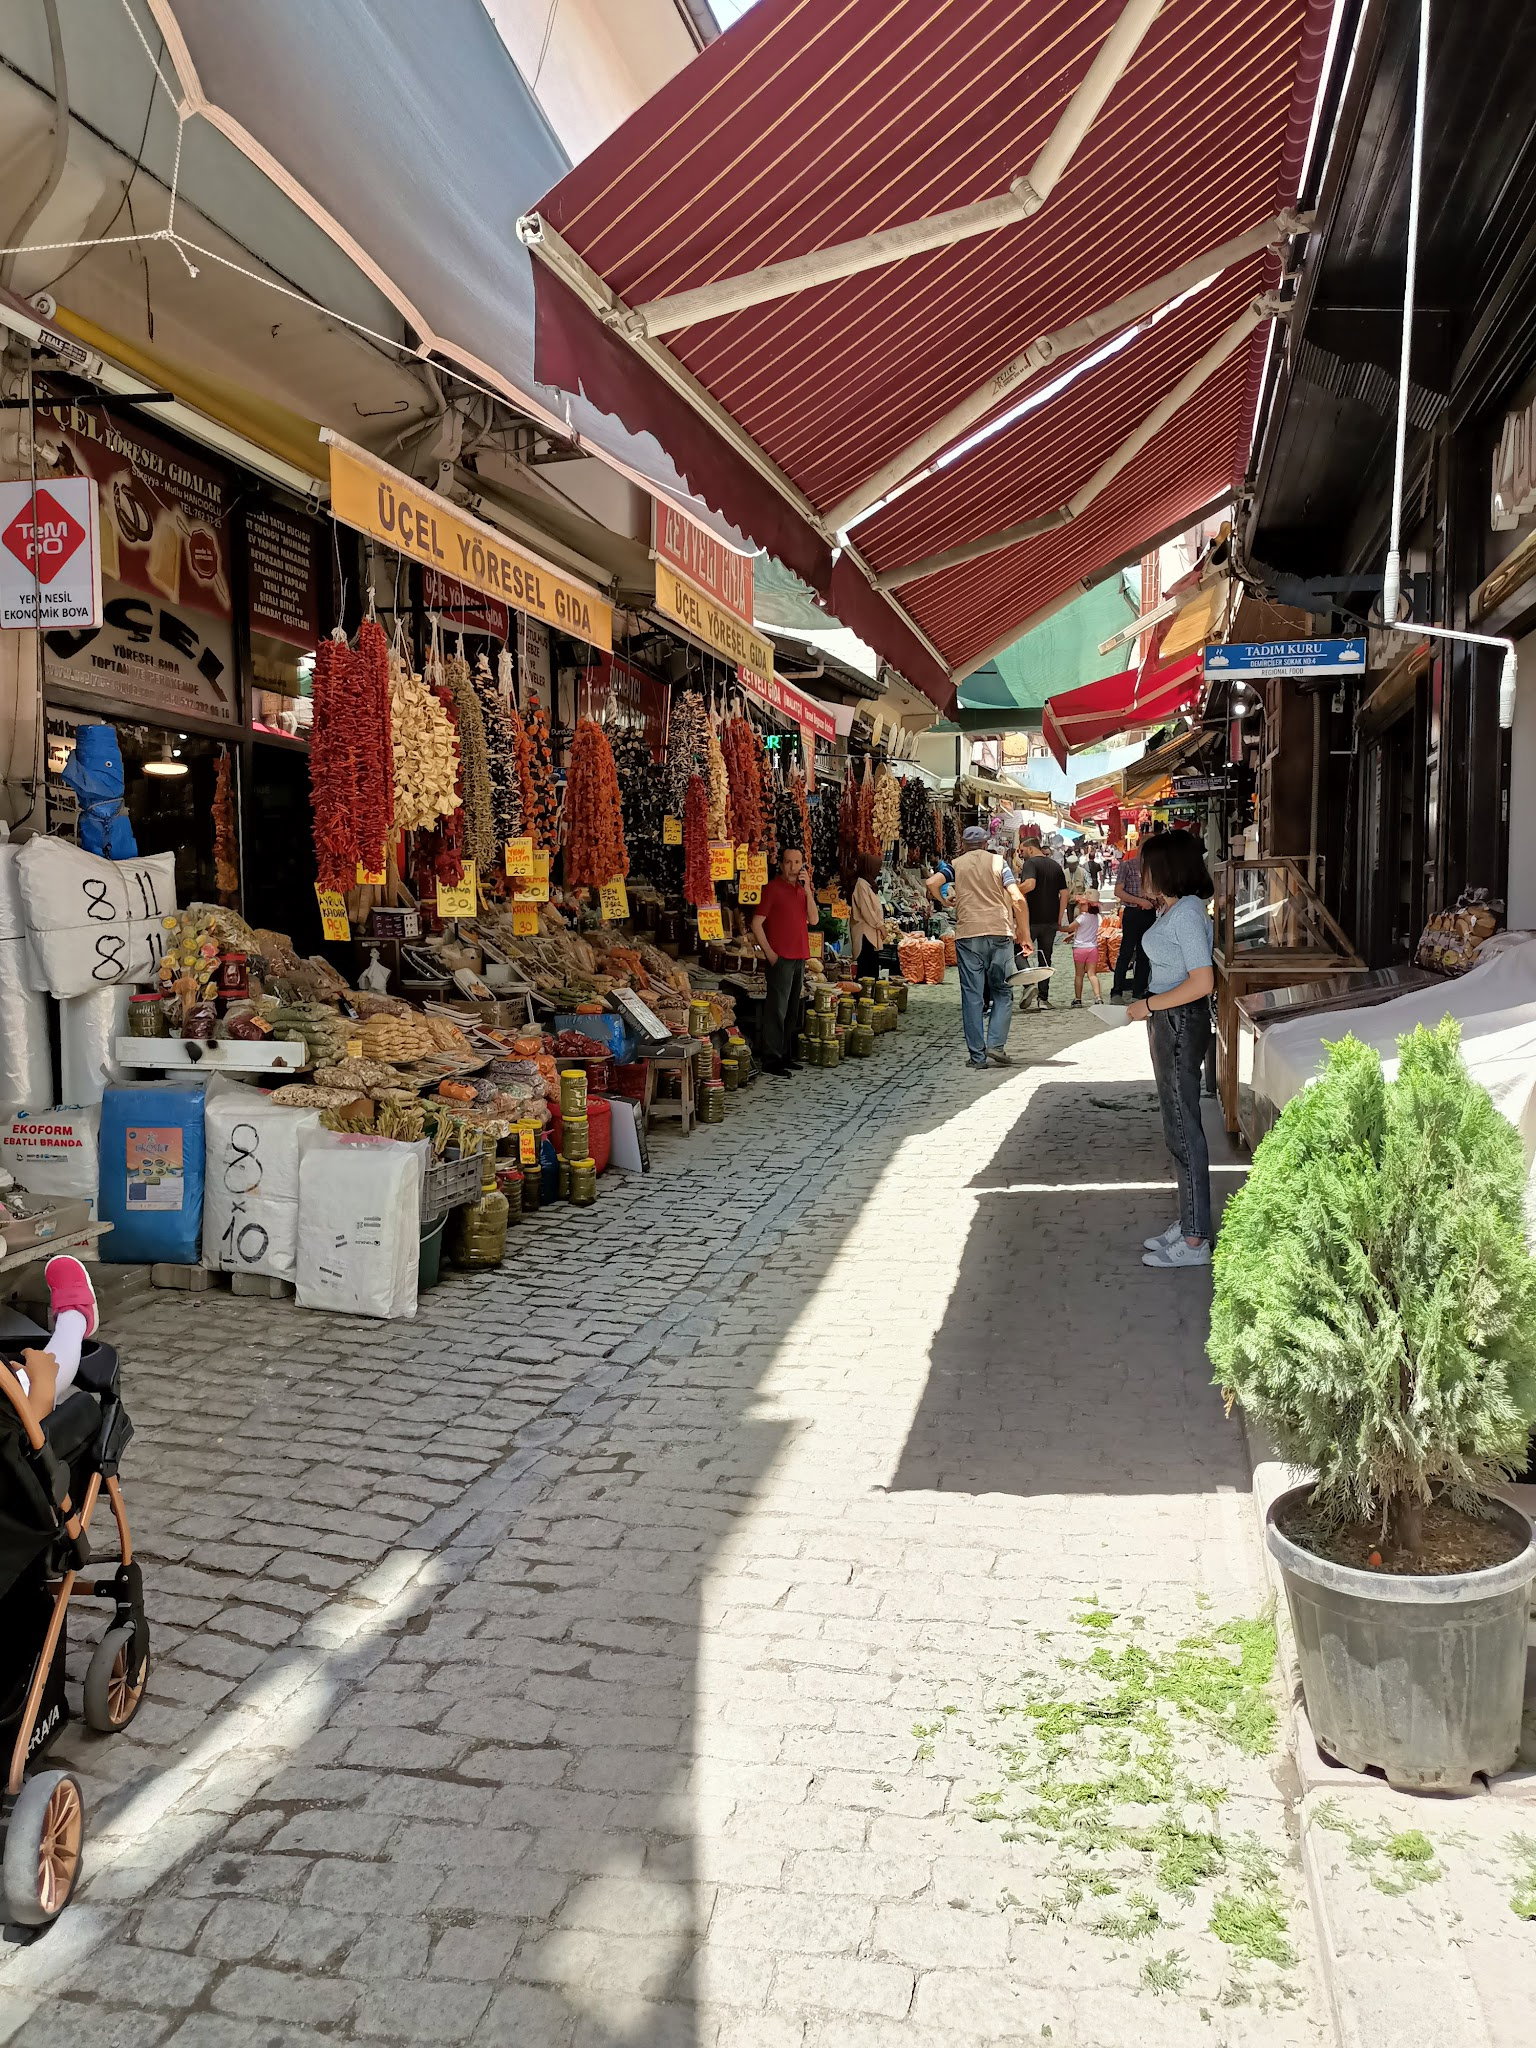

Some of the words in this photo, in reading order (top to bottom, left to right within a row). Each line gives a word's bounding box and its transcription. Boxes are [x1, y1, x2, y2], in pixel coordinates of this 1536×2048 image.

[105, 427, 167, 476] YÖRESEL
[169, 462, 222, 504] GIDALAR
[164, 481, 183, 498] Mutlu
[377, 482, 444, 559] ÜÇEL
[456, 533, 546, 610] YÖRESEL
[554, 588, 592, 634] GIDA
[253, 562, 282, 582] SALAMUR
[44, 591, 73, 603] NESİL
[62, 607, 89, 618] BOYA
[253, 602, 281, 620] BAHARAT
[675, 582, 702, 629] ÜÇEL
[707, 610, 747, 659] YÖRESEL
[749, 642, 768, 673] GIDA
[113, 644, 155, 667] YÖRESEL
[525, 642, 540, 657] EBZE
[1245, 644, 1285, 656] TADIM
[1288, 643, 1323, 654] KURU
[91, 654, 130, 676] TOPTAN
[148, 670, 200, 696] PERAKENDE
[513, 867, 526, 875] 20
[712, 867, 727, 876] 35
[83, 879, 116, 920] 8
[742, 892, 757, 903] 30
[327, 918, 343, 931] ACI
[519, 921, 532, 933] 30
[92, 935, 125, 980] 8
[12, 1124, 73, 1136] EKOFORM
[3, 1137, 37, 1146] EBATLI
[40, 1139, 83, 1147] BRANDA
[224, 1123, 263, 1194] 8
[222, 1216, 269, 1264] 10
